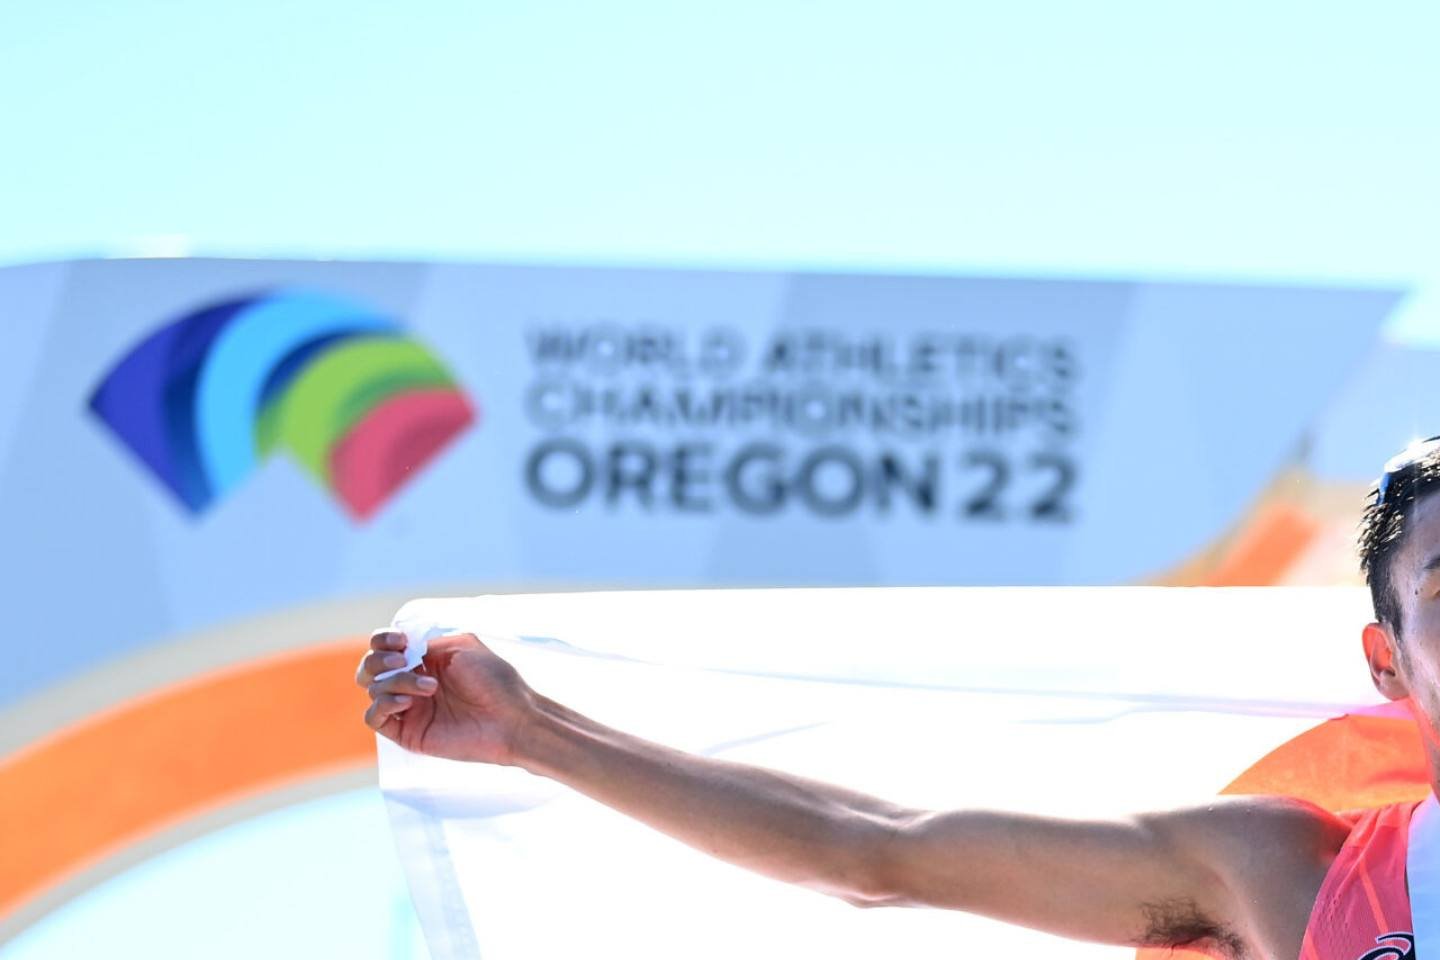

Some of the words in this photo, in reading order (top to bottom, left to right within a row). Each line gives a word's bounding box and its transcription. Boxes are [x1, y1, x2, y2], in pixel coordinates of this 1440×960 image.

[524, 324, 746, 374] WORLD
[764, 331, 1078, 392] ATHLETICS
[525, 380, 1077, 442] CHAMPIONSHIPS
